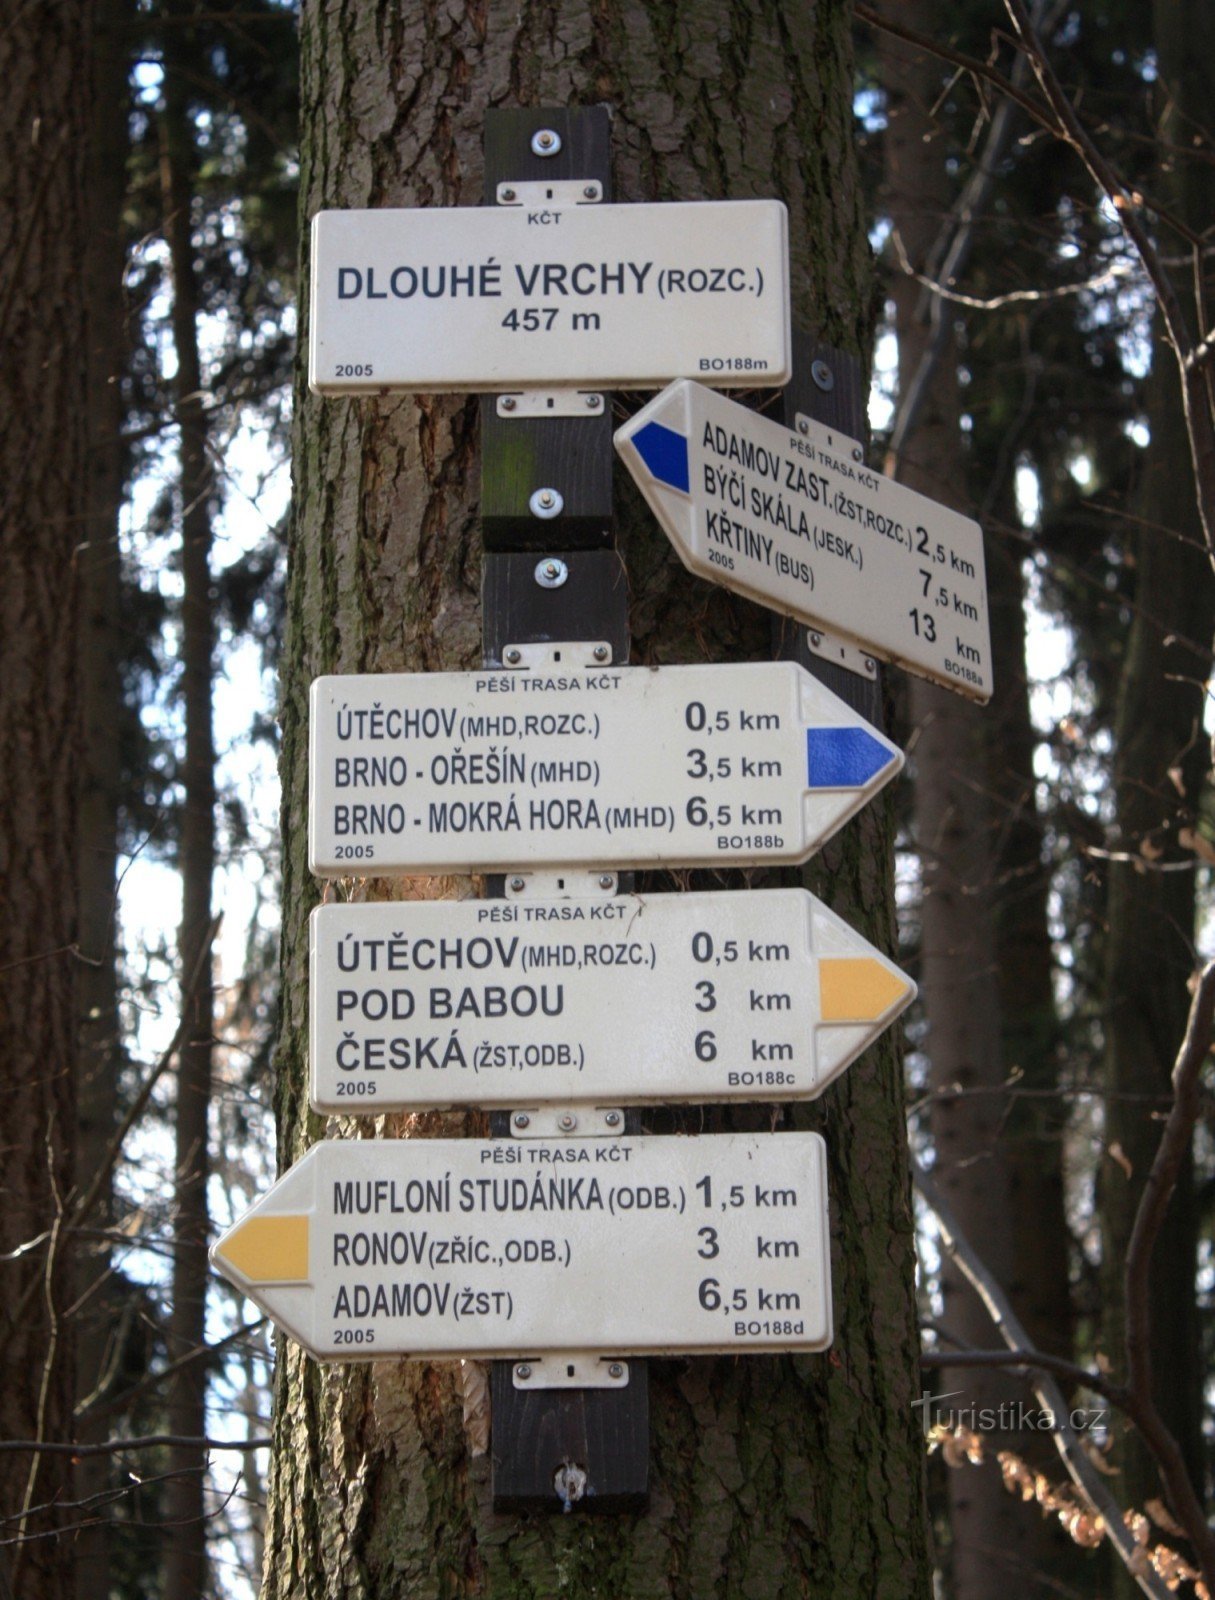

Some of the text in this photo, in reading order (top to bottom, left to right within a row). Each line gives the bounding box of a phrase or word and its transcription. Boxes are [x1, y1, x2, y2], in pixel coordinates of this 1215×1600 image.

[528, 211, 561, 224] KČT
[338, 257, 501, 299] DLOUHÉ
[502, 308, 600, 331] 457 m
[336, 365, 373, 376] 2005
[790, 437, 880, 492] PĚŠÍ TRASA KČT
[703, 422, 779, 482] ADAMOV
[916, 527, 945, 564] 2,5
[951, 550, 975, 577] km
[705, 464, 746, 510] BÝČÍ
[919, 569, 948, 606] 7,5
[954, 593, 978, 621] km
[708, 549, 735, 570] 2005
[909, 608, 936, 643] 13
[957, 637, 981, 664] km
[477, 675, 620, 692] PĚŠÍ TRASA KČT
[686, 702, 729, 735] 0,5
[740, 711, 779, 730] km
[336, 756, 407, 787] BRNO
[687, 749, 731, 782] 3,5
[742, 757, 781, 777] km
[335, 804, 405, 835] BRNO
[430, 793, 521, 833] MOKRÁ
[686, 796, 731, 830] 6,5
[742, 805, 781, 825] km
[335, 846, 373, 858] 2005
[479, 904, 626, 922] PĚŠÍ TRASA KČT
[692, 932, 738, 966] 0,5
[749, 940, 789, 961] km
[337, 981, 790, 1021] POD BABOU 3 km
[695, 1030, 717, 1062] 6
[752, 1040, 793, 1060] km
[337, 1082, 376, 1095] 2005
[481, 1145, 632, 1163] PĚŠÍ TRASA KČT
[334, 1172, 450, 1214] MUFLONÍ
[696, 1176, 744, 1211] 1,5
[756, 1185, 796, 1207] km
[698, 1227, 719, 1259] 3
[758, 1236, 799, 1258] km
[699, 1278, 747, 1315] 6,5
[758, 1288, 800, 1310] km
[334, 1329, 374, 1344] 2005
